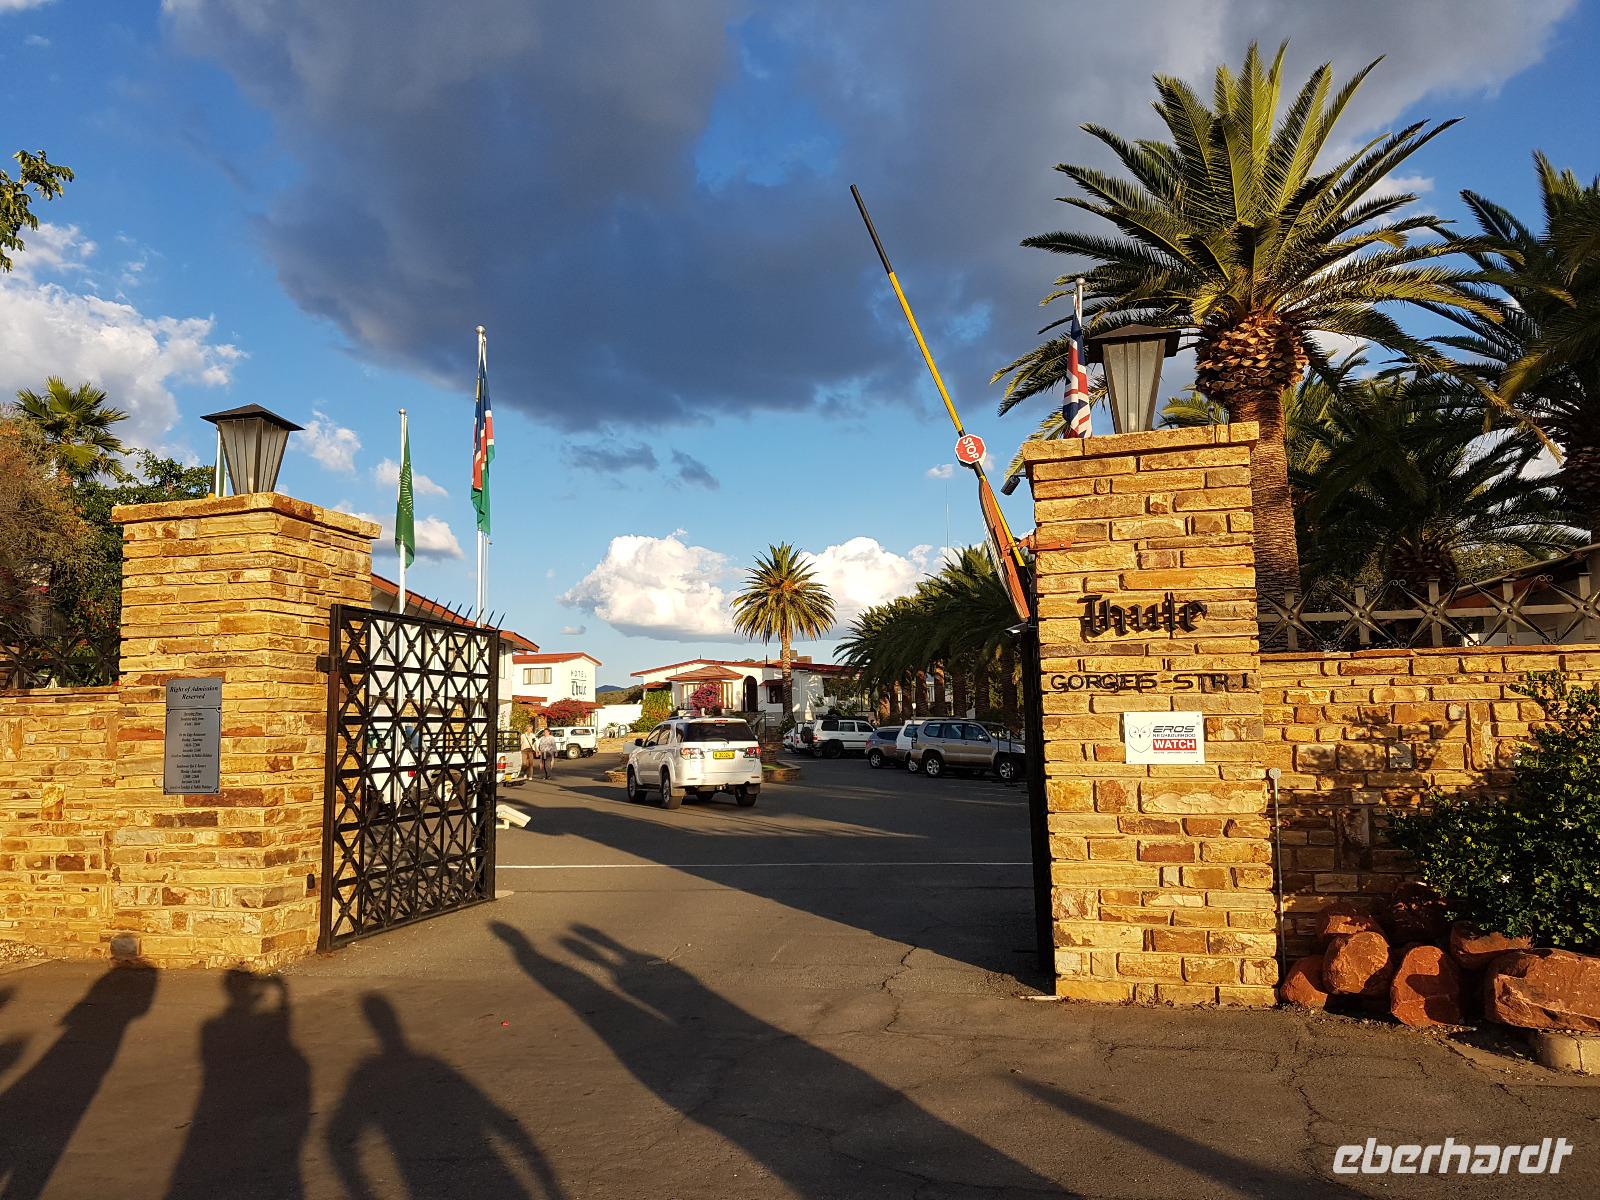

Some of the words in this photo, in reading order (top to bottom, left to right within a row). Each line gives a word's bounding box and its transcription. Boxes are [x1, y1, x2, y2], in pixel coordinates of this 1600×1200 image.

[962, 437, 980, 459] STOP
[570, 669, 587, 679] HOTEL
[184, 686, 191, 694] of
[1152, 725, 1196, 733] EROS
[1153, 739, 1196, 749] WATCH
